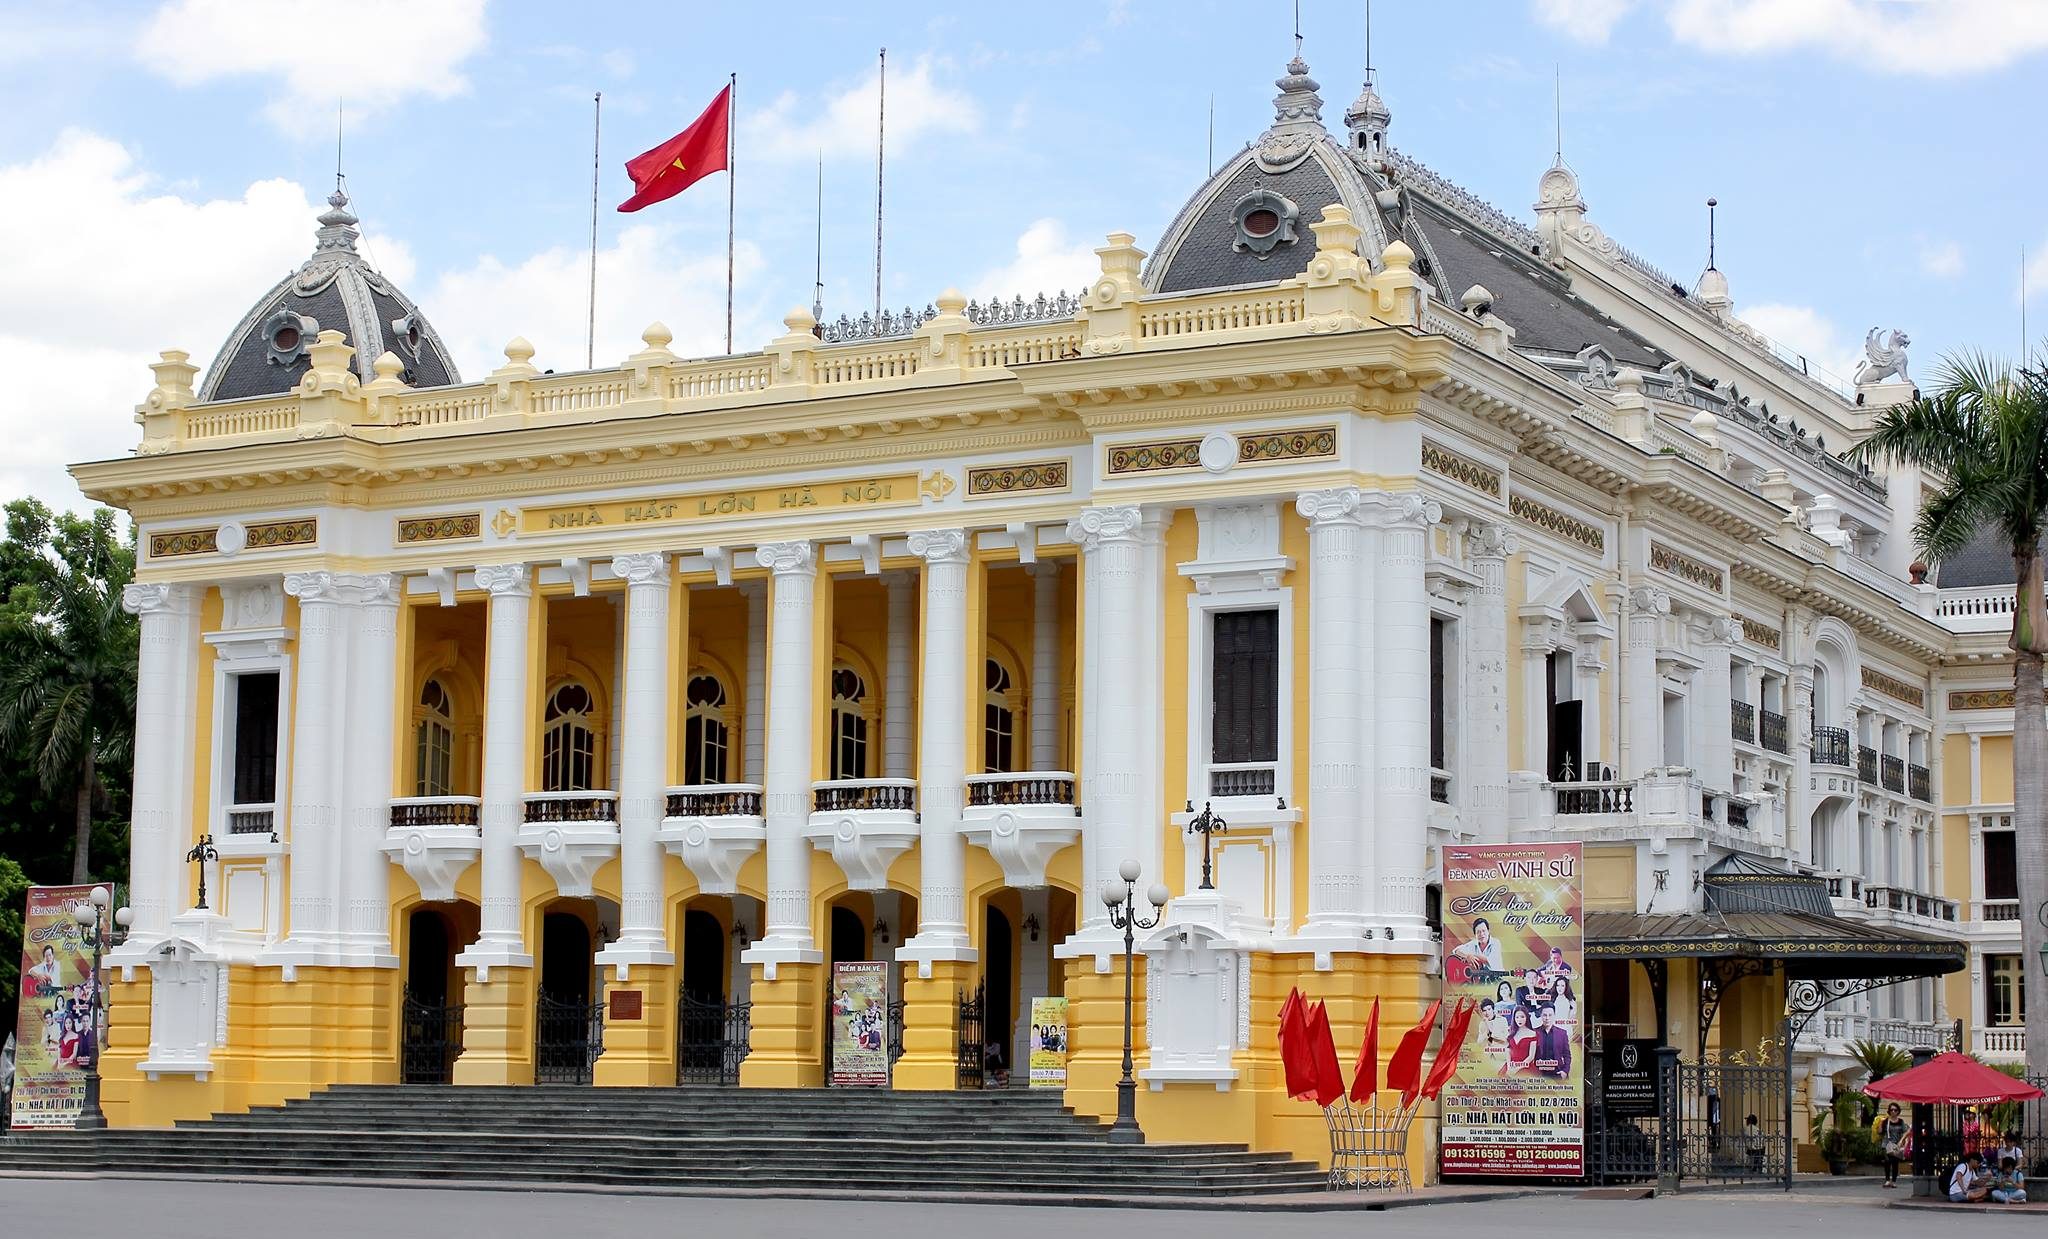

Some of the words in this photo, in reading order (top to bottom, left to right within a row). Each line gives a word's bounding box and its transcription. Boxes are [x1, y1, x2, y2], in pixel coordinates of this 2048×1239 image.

[549, 504, 603, 528] NHÀ
[698, 492, 756, 515] LỚN
[779, 485, 818, 508] HÀ
[842, 479, 892, 503] NỘI
[1449, 869, 1469, 880] ĐÊM
[1470, 869, 1497, 881] NHẠC
[1498, 861, 1543, 878] VINH
[1549, 855, 1574, 878] SỬ
[1503, 912, 1528, 931] tay
[1528, 1097, 1539, 1107] 01,
[1540, 1097, 1578, 1107] 02/8/2015
[1446, 1113, 1463, 1126] TẠI:
[1466, 1111, 1488, 1124] NHÀ
[1492, 1110, 1512, 1124] HÁT
[1515, 1110, 1536, 1125] LỚN
[1539, 1110, 1554, 1125] HÀ
[1558, 1110, 1578, 1127] NỘI
[1444, 1148, 1506, 1159] 0913316596
[1516, 1149, 1580, 1160] 0912600096
